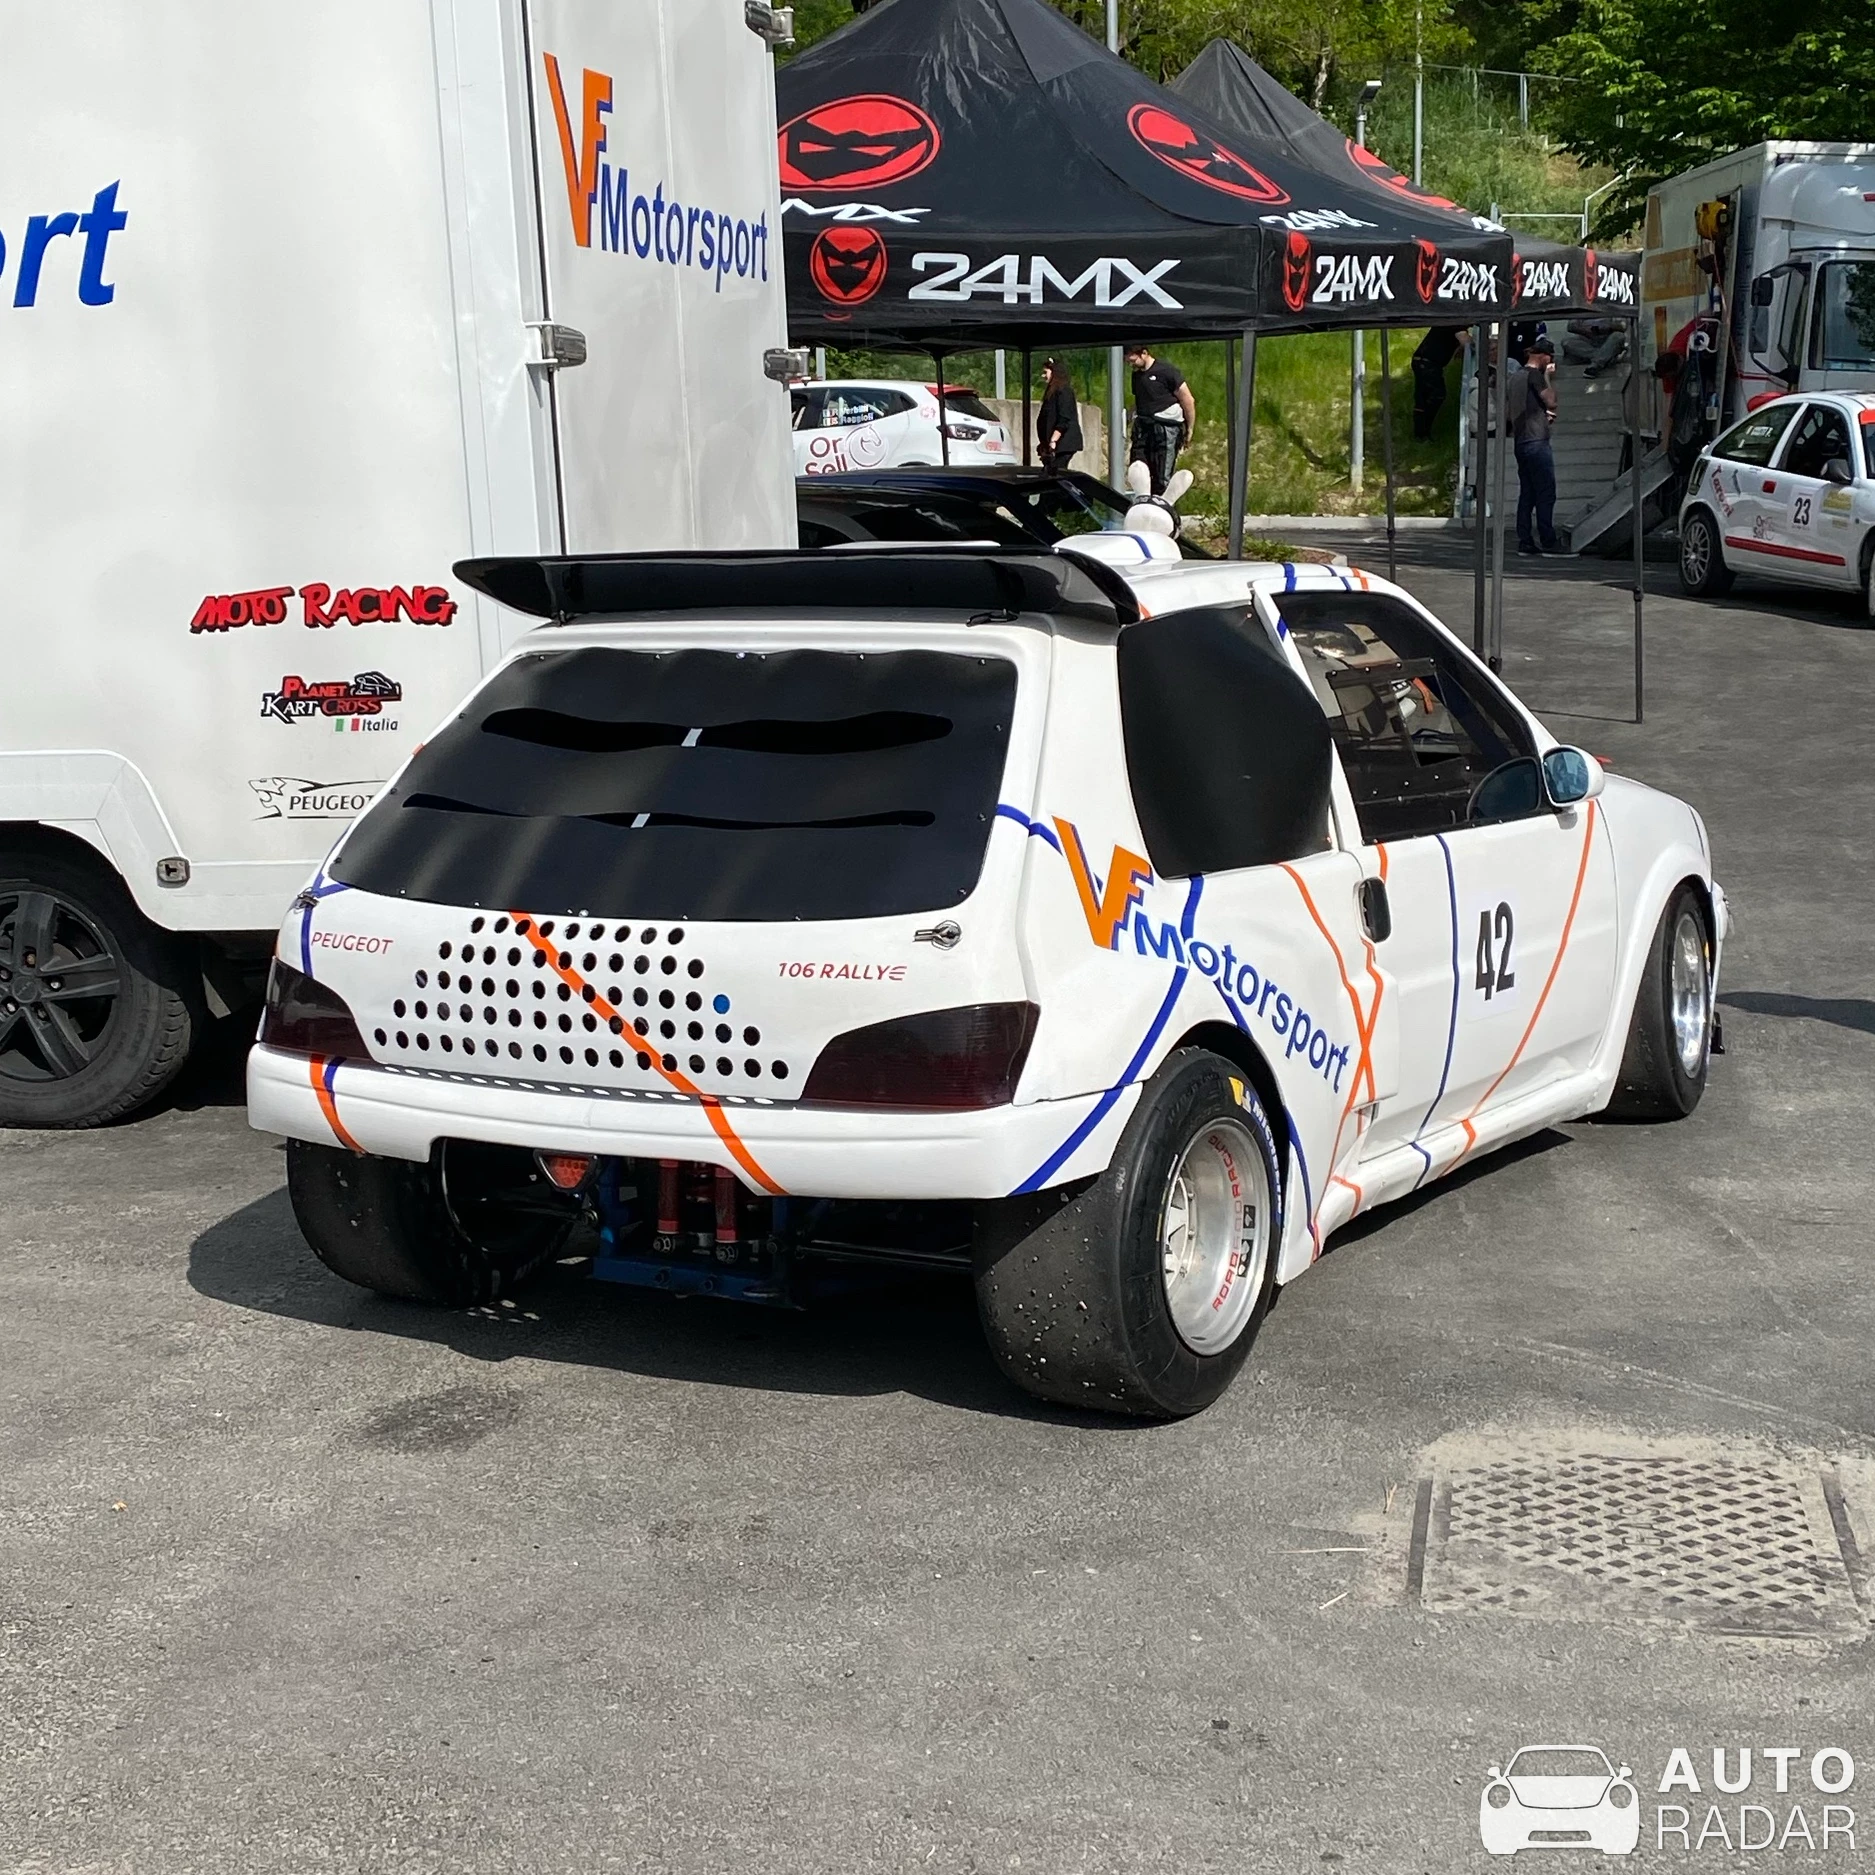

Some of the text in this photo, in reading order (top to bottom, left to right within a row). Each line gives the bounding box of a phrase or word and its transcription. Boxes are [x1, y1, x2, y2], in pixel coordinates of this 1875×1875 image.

[0, 179, 129, 308] rt
[600, 163, 768, 292] Motorsport
[908, 252, 1184, 309] 24MX
[1312, 255, 1395, 302] 24MX
[1437, 258, 1498, 303] 24MX
[1521, 261, 1570, 297] 24MX
[1598, 265, 1634, 305] 24MX
[810, 436, 843, 458] Or
[1793, 497, 1811, 525] 23
[189, 582, 458, 634] MOTO RACING
[362, 718, 398, 731] Italia
[311, 932, 394, 956] PEUGEOT
[1474, 901, 1515, 1001] 42
[777, 961, 908, 982] 106 RALLYE
[1135, 911, 1349, 1094] Motorsport
